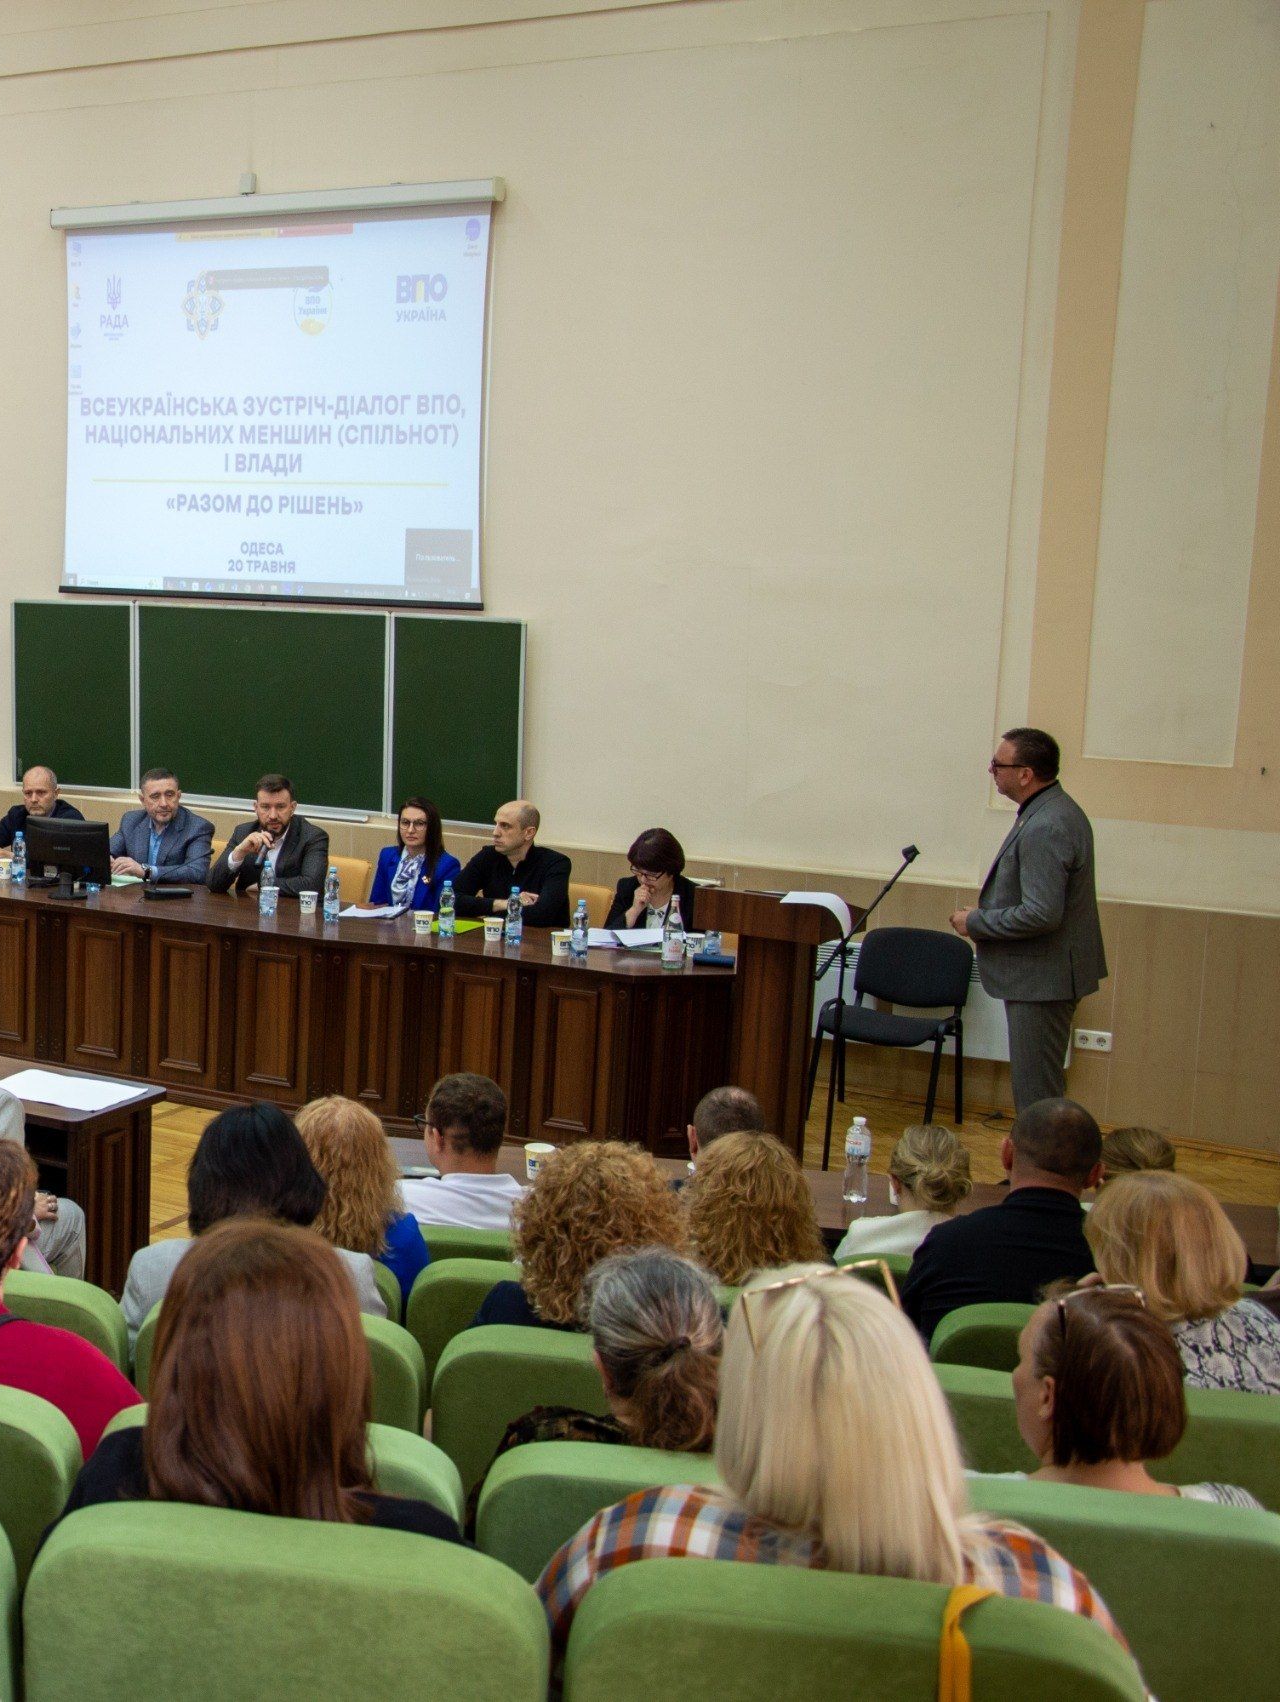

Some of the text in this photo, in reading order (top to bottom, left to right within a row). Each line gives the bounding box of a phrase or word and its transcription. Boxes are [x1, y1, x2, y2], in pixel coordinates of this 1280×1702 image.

[395, 274, 448, 304] ВПО
[100, 314, 130, 331] РАДА
[395, 306, 447, 322] УКРАЇНА
[80, 392, 466, 419] ВСЕУКРАЇНСЬКА ЗУСТРІЧ-ДІАЛОГ ВПО,
[85, 424, 459, 447] НАЦІОНАЛЬНИХ МЕНШИН (СПІЛЬНОТ)
[235, 453, 303, 477] ВЛАДИ
[166, 493, 364, 516] «РАЗОМ ДО РІШЕНЬ»
[240, 541, 284, 557] ОДЕСА
[227, 559, 296, 574] 20 ТРАВНЯ
